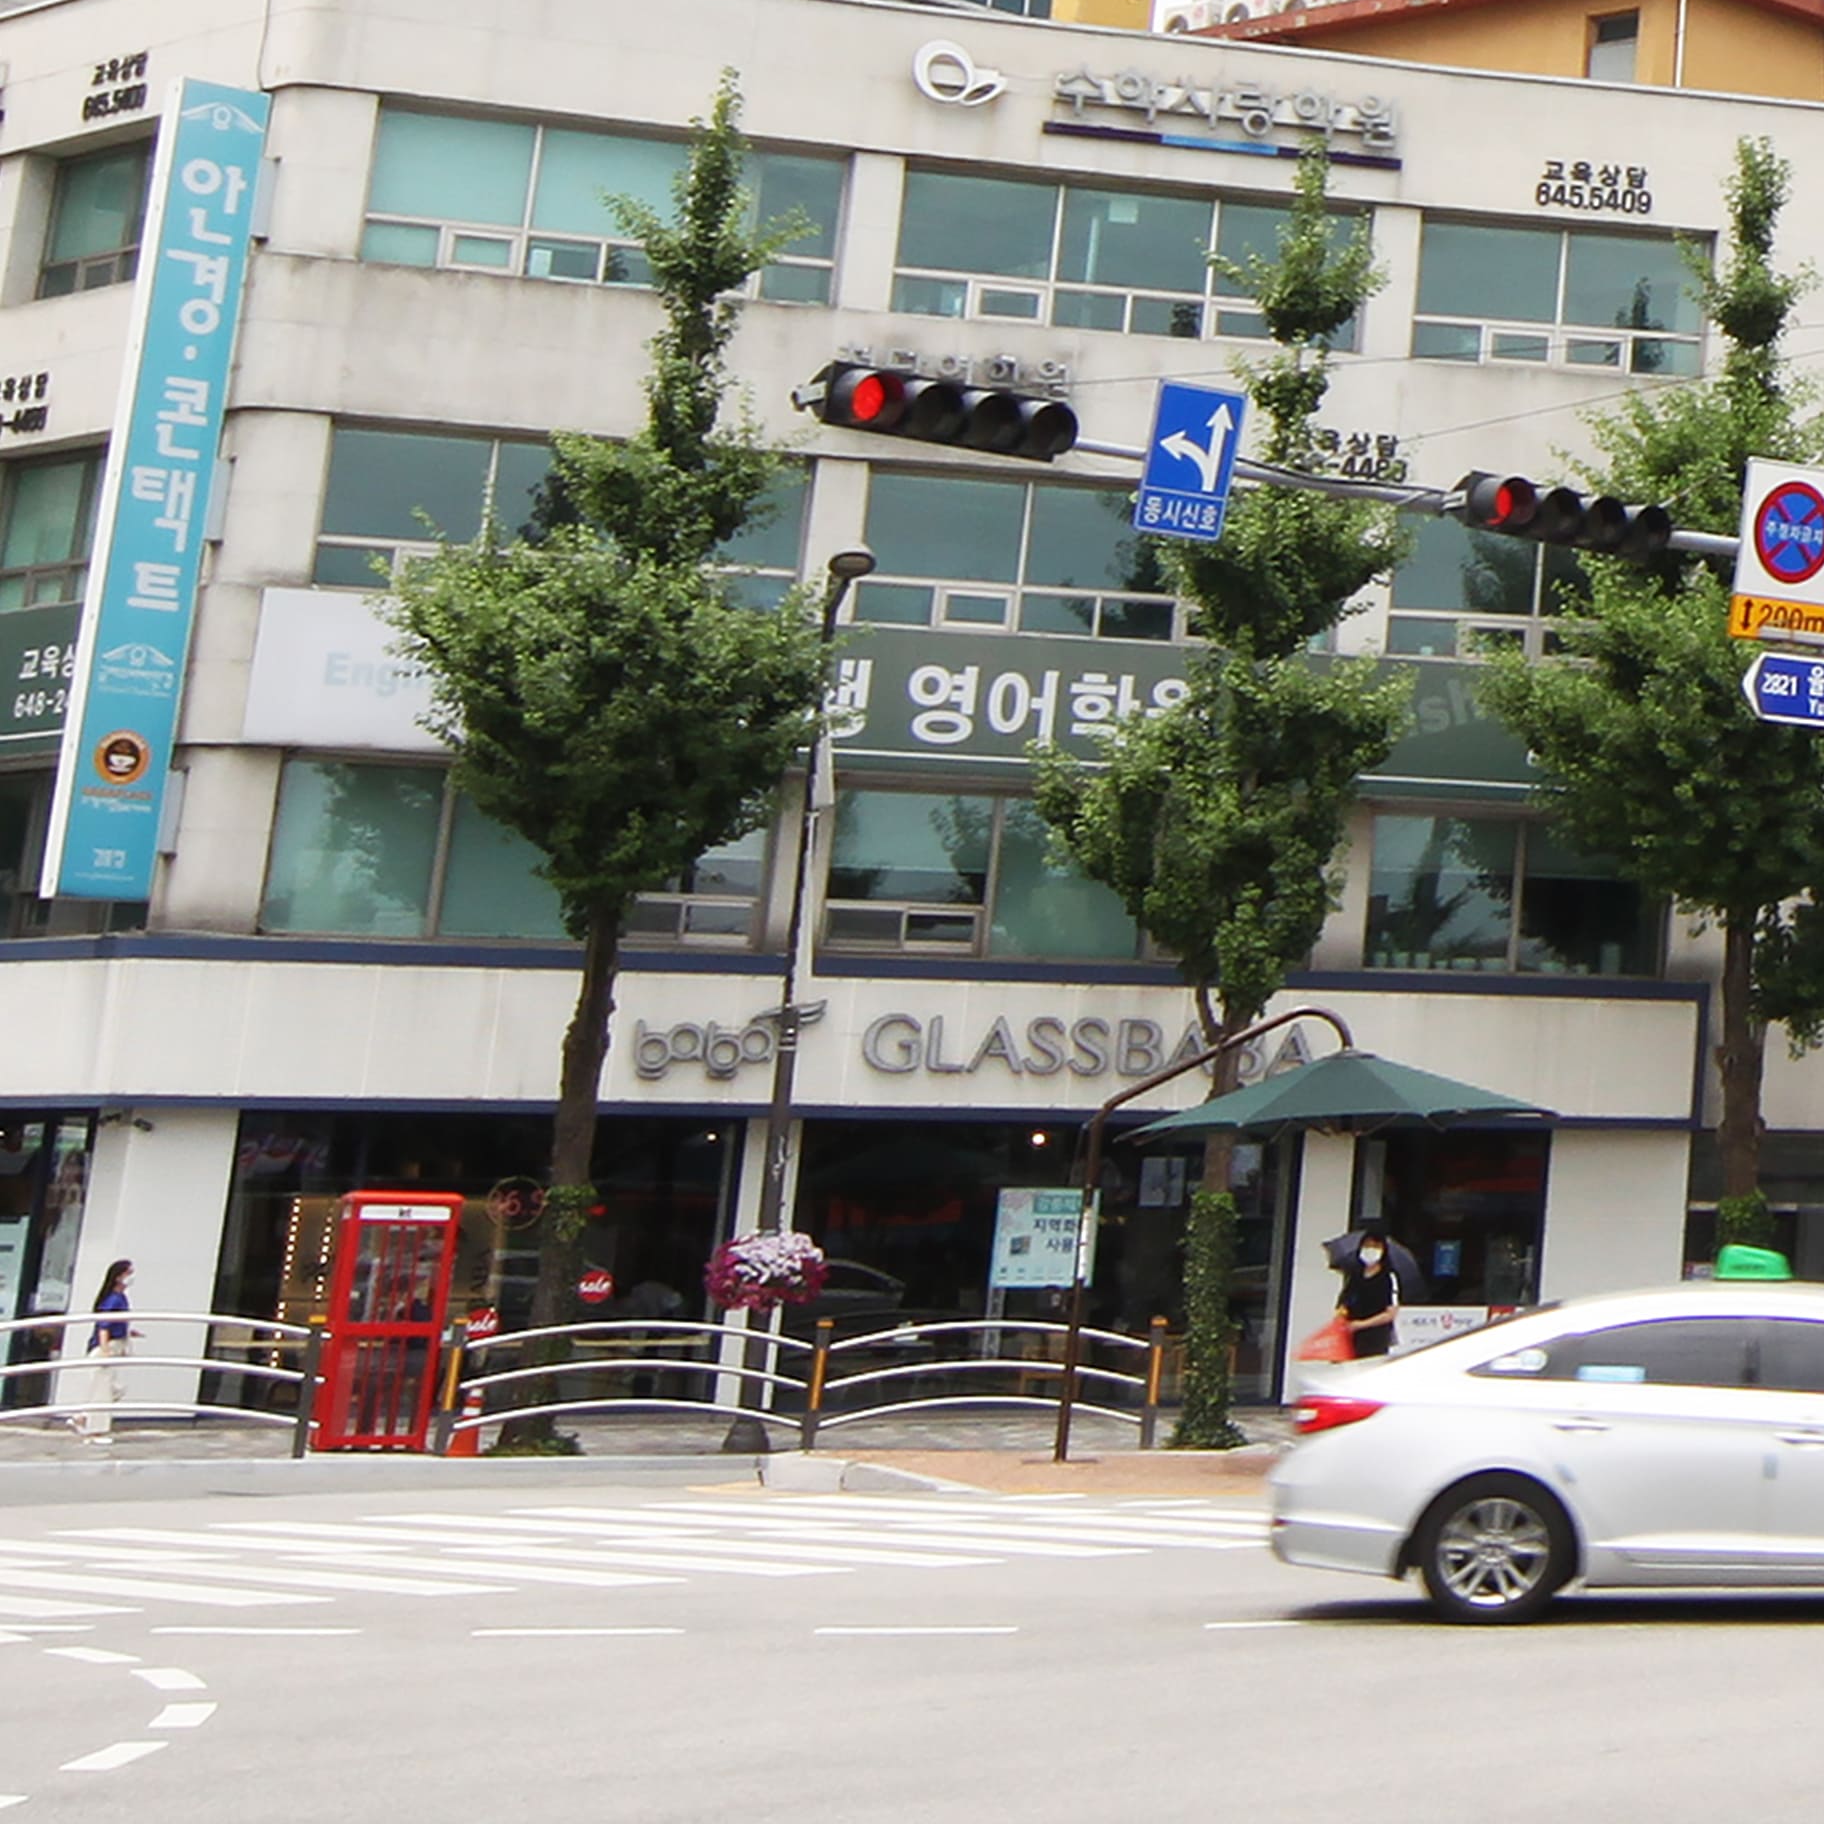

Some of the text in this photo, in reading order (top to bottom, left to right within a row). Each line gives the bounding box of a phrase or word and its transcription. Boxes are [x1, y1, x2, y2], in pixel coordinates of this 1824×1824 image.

[1054, 64, 1398, 148] 수학사랑학원
[1543, 160, 1648, 189] 교육상담
[1536, 184, 1652, 215] 645.5409
[1142, 496, 1219, 531] 동시신호
[1765, 520, 1824, 545] 주정차금지
[1758, 603, 1824, 633] 200m
